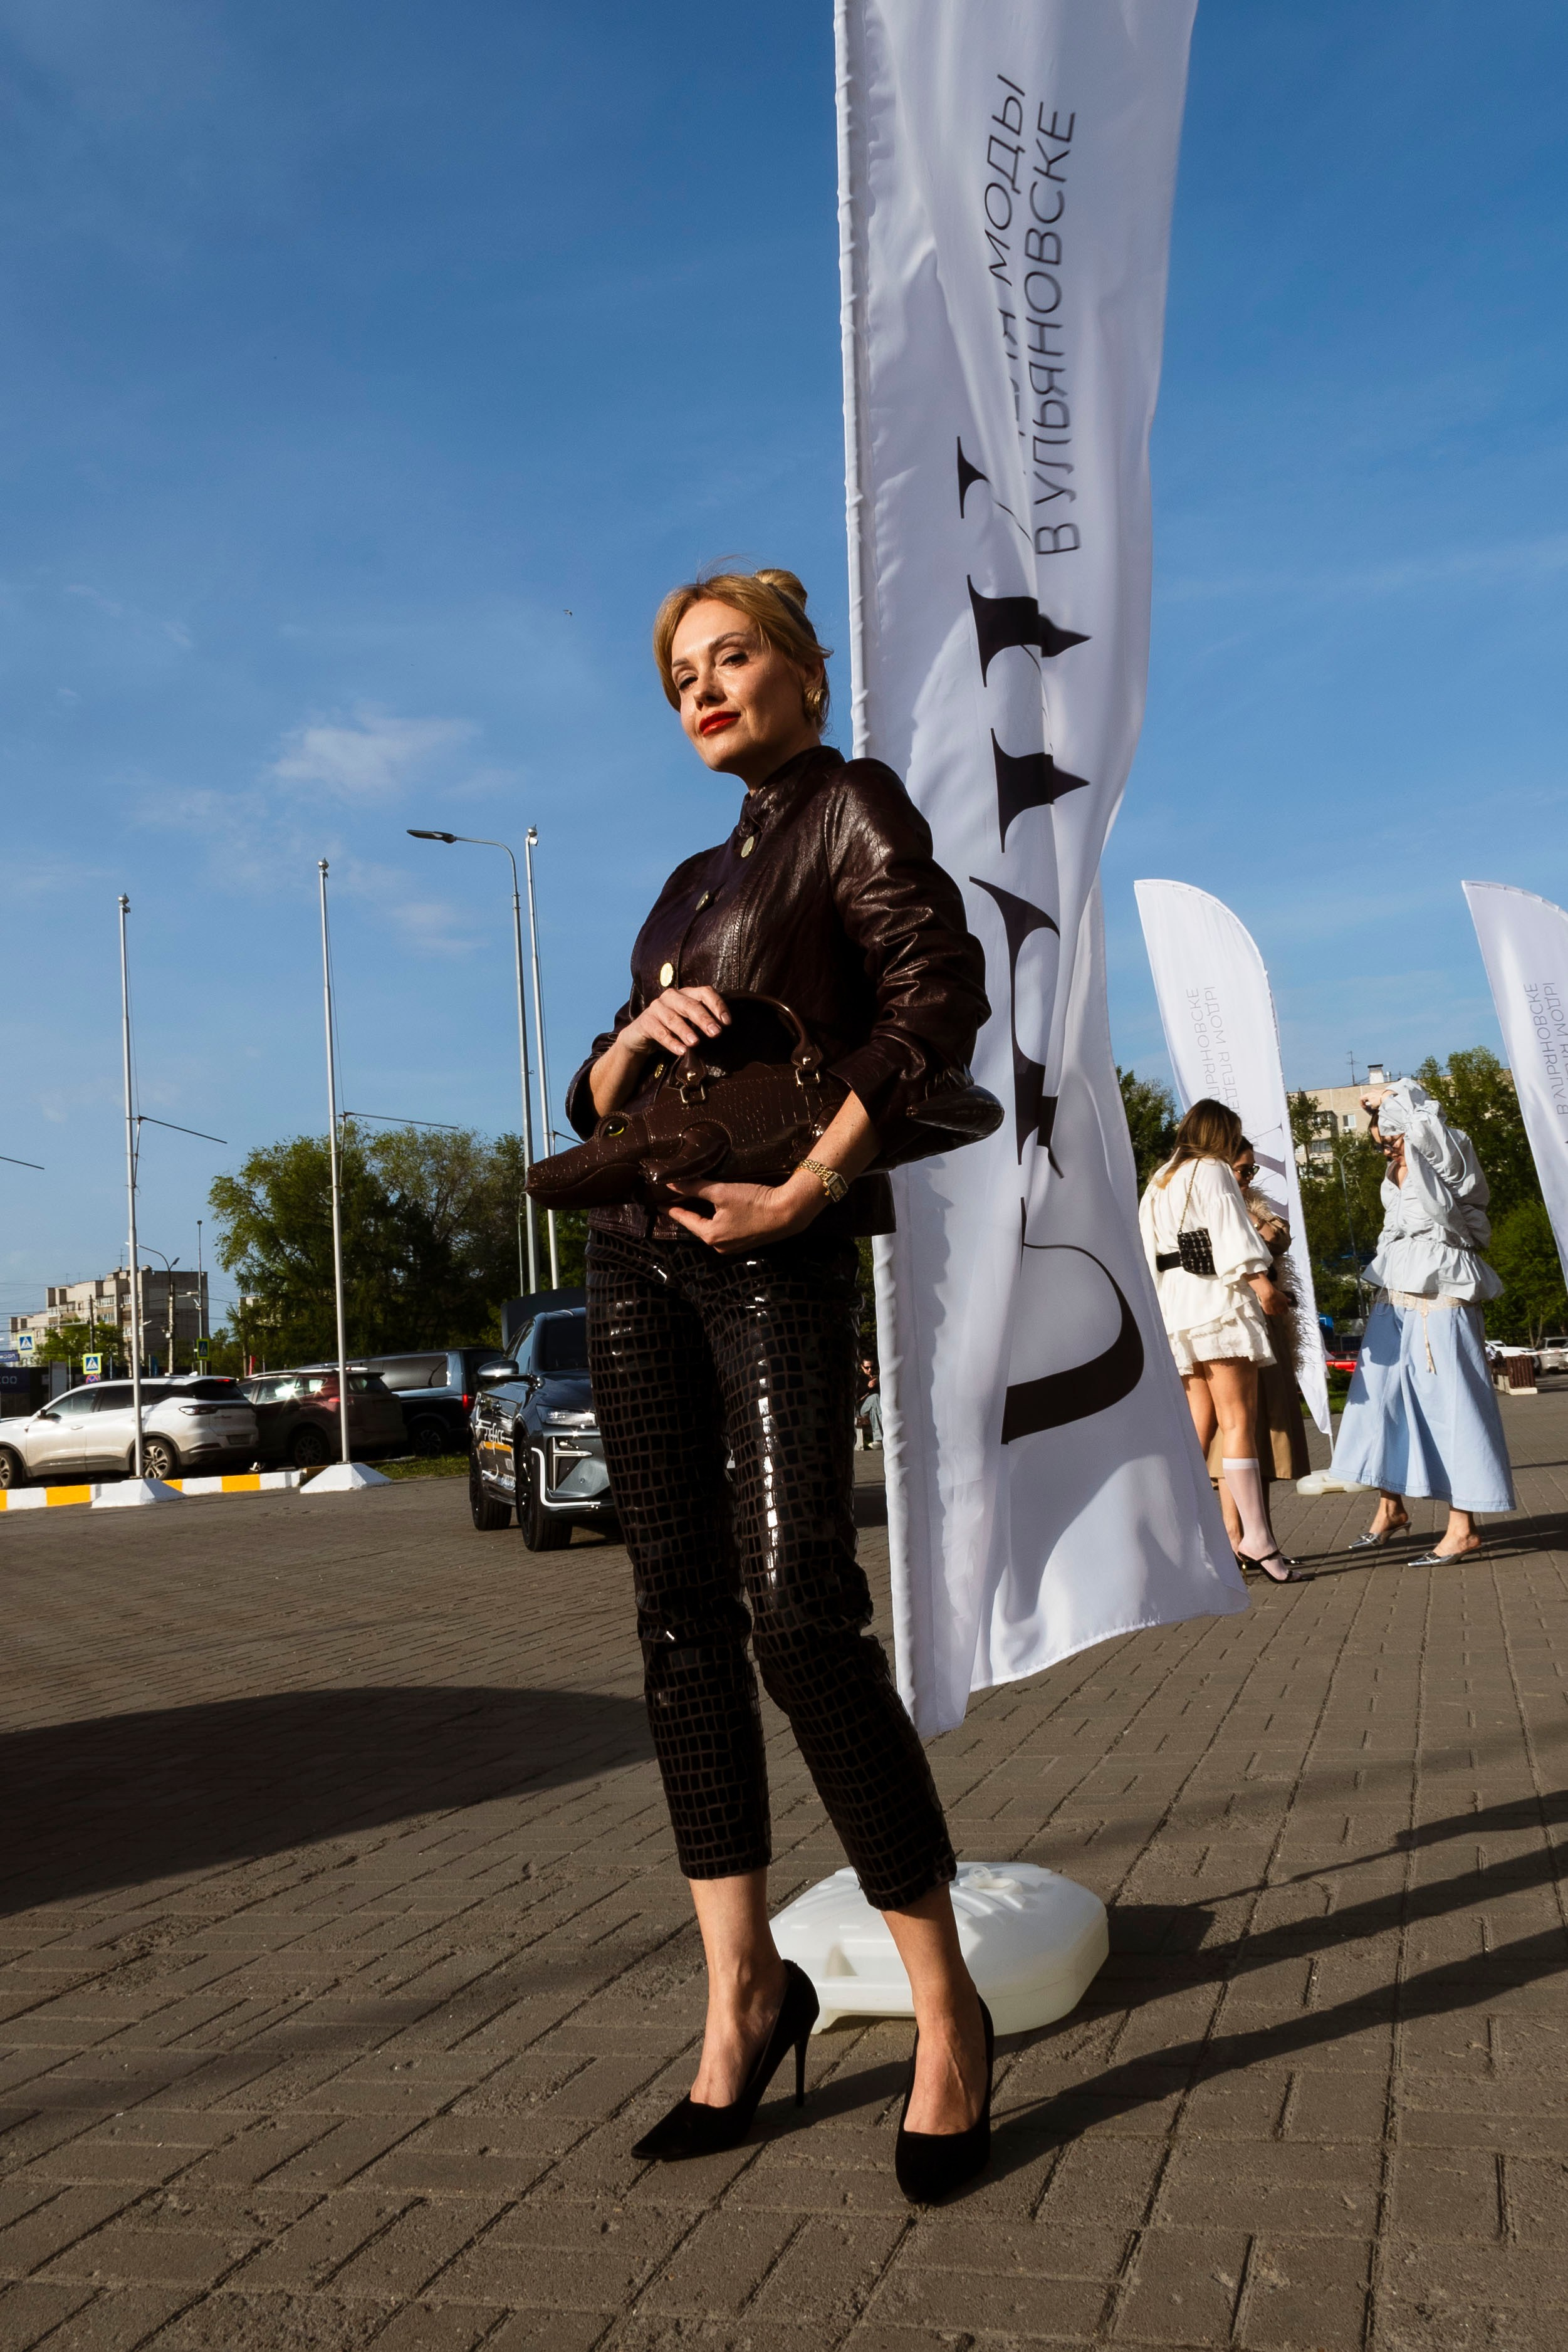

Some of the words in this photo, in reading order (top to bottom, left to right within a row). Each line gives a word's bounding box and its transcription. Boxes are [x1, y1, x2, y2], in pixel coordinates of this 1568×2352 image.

[985, 74, 1025, 286] МОДЫ
[1024, 102, 1076, 504] УЛЬЯНОВСКЕ
[1034, 523, 1081, 555] В
